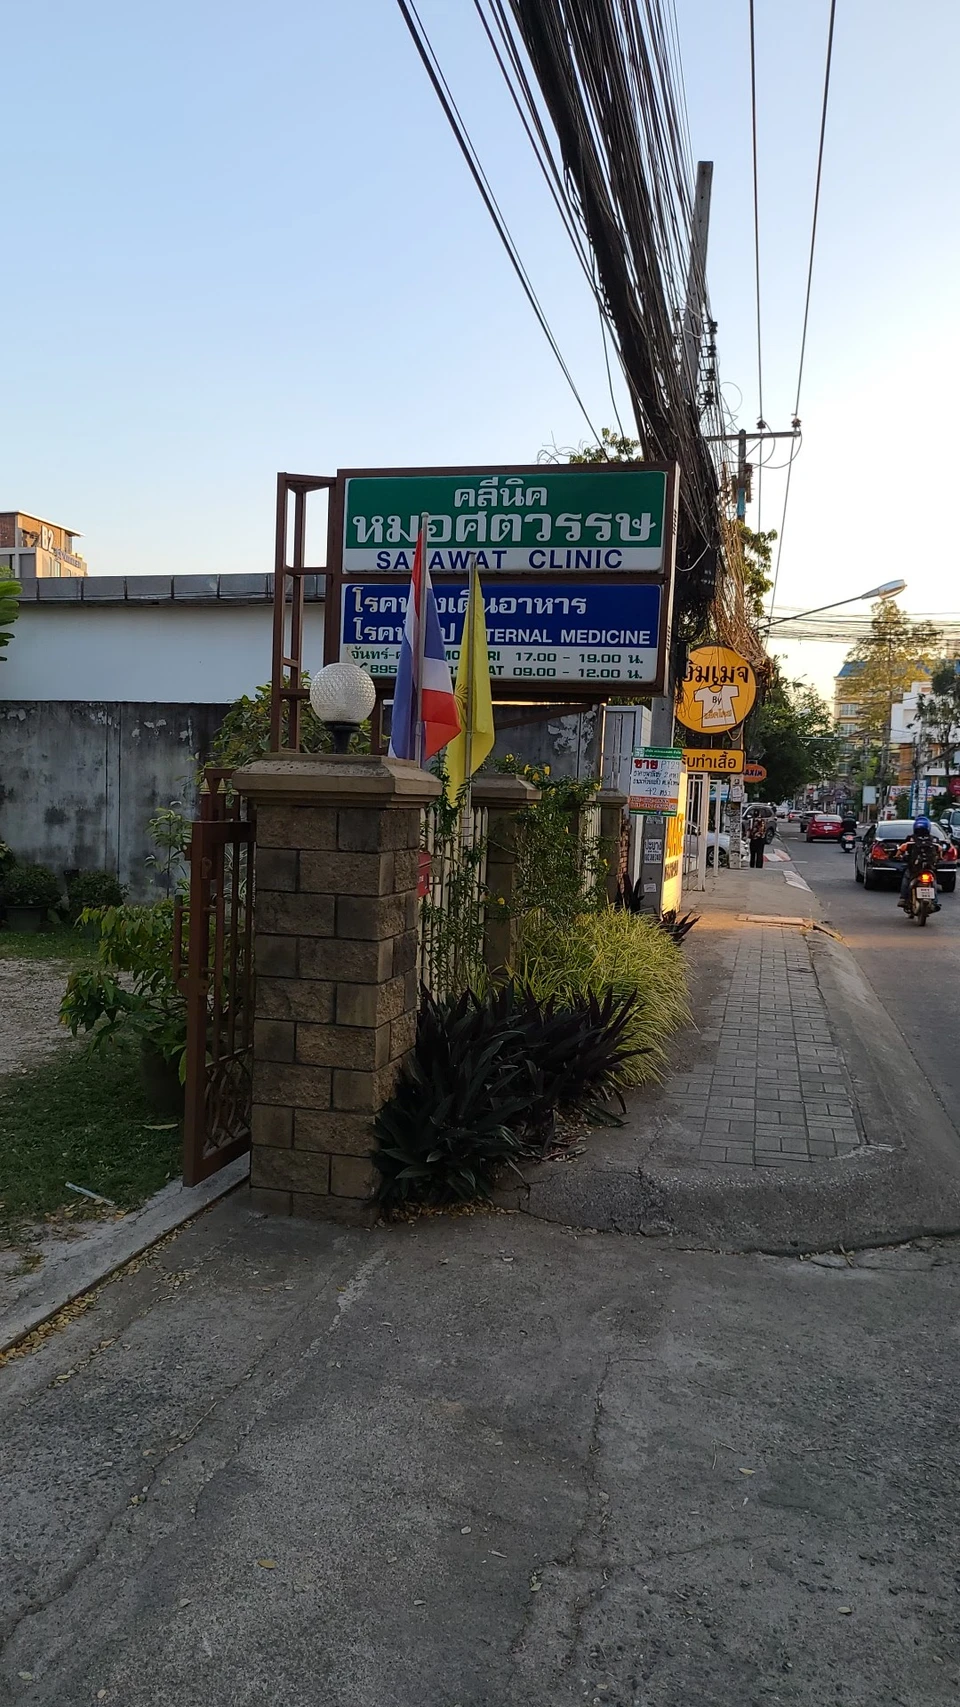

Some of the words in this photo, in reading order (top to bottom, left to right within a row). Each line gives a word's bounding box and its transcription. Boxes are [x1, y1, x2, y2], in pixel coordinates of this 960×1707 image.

[454, 476, 548, 508] คลีนิค
[352, 511, 657, 543] หมอศตวรรษ
[376, 550, 507, 570] SAAWAT
[528, 549, 623, 570] CLINIC
[485, 628, 552, 643] TERNAL
[560, 629, 650, 645] MEDICINE
[488, 650, 500, 662] RI
[515, 652, 556, 662] 17.00
[579, 653, 621, 664] 19.00
[628, 654, 643, 664] น.
[488, 665, 504, 676] AT
[513, 667, 556, 677] 09.00
[578, 668, 620, 679] 12.00
[627, 669, 642, 679] น.
[712, 696, 722, 705] By
[634, 759, 658, 769] ขาย
